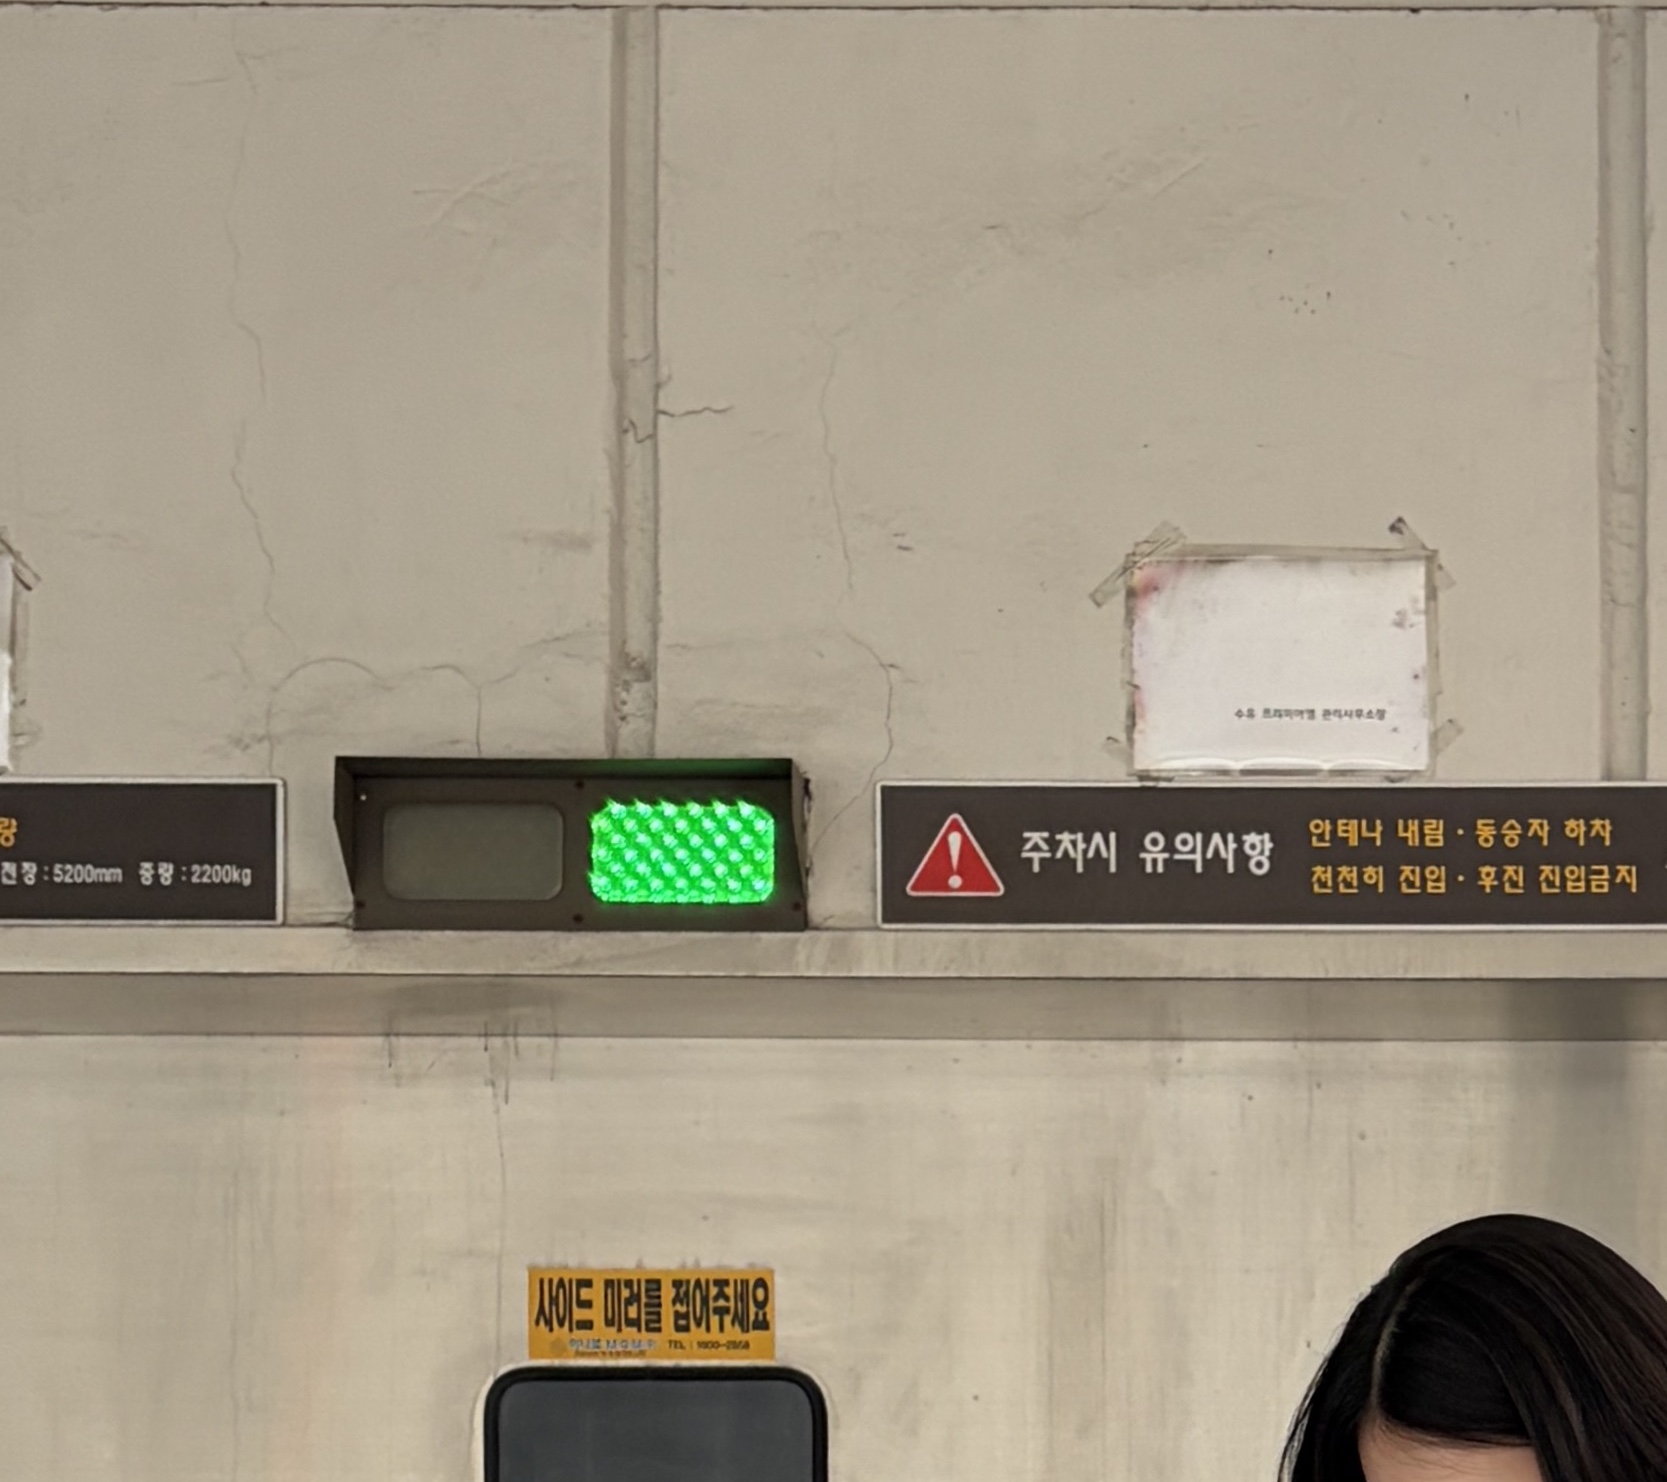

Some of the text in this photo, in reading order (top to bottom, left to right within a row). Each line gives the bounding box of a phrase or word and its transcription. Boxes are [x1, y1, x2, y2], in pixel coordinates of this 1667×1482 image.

[1309, 818, 1613, 848] 안테나 내림 동승자 하차
[1020, 831, 1274, 876] 주차시 유의사항
[1311, 865, 1638, 893] 천천히 진입 후진 진입금지
[535, 1277, 770, 1333] 사이드 미러를 접어주세요
